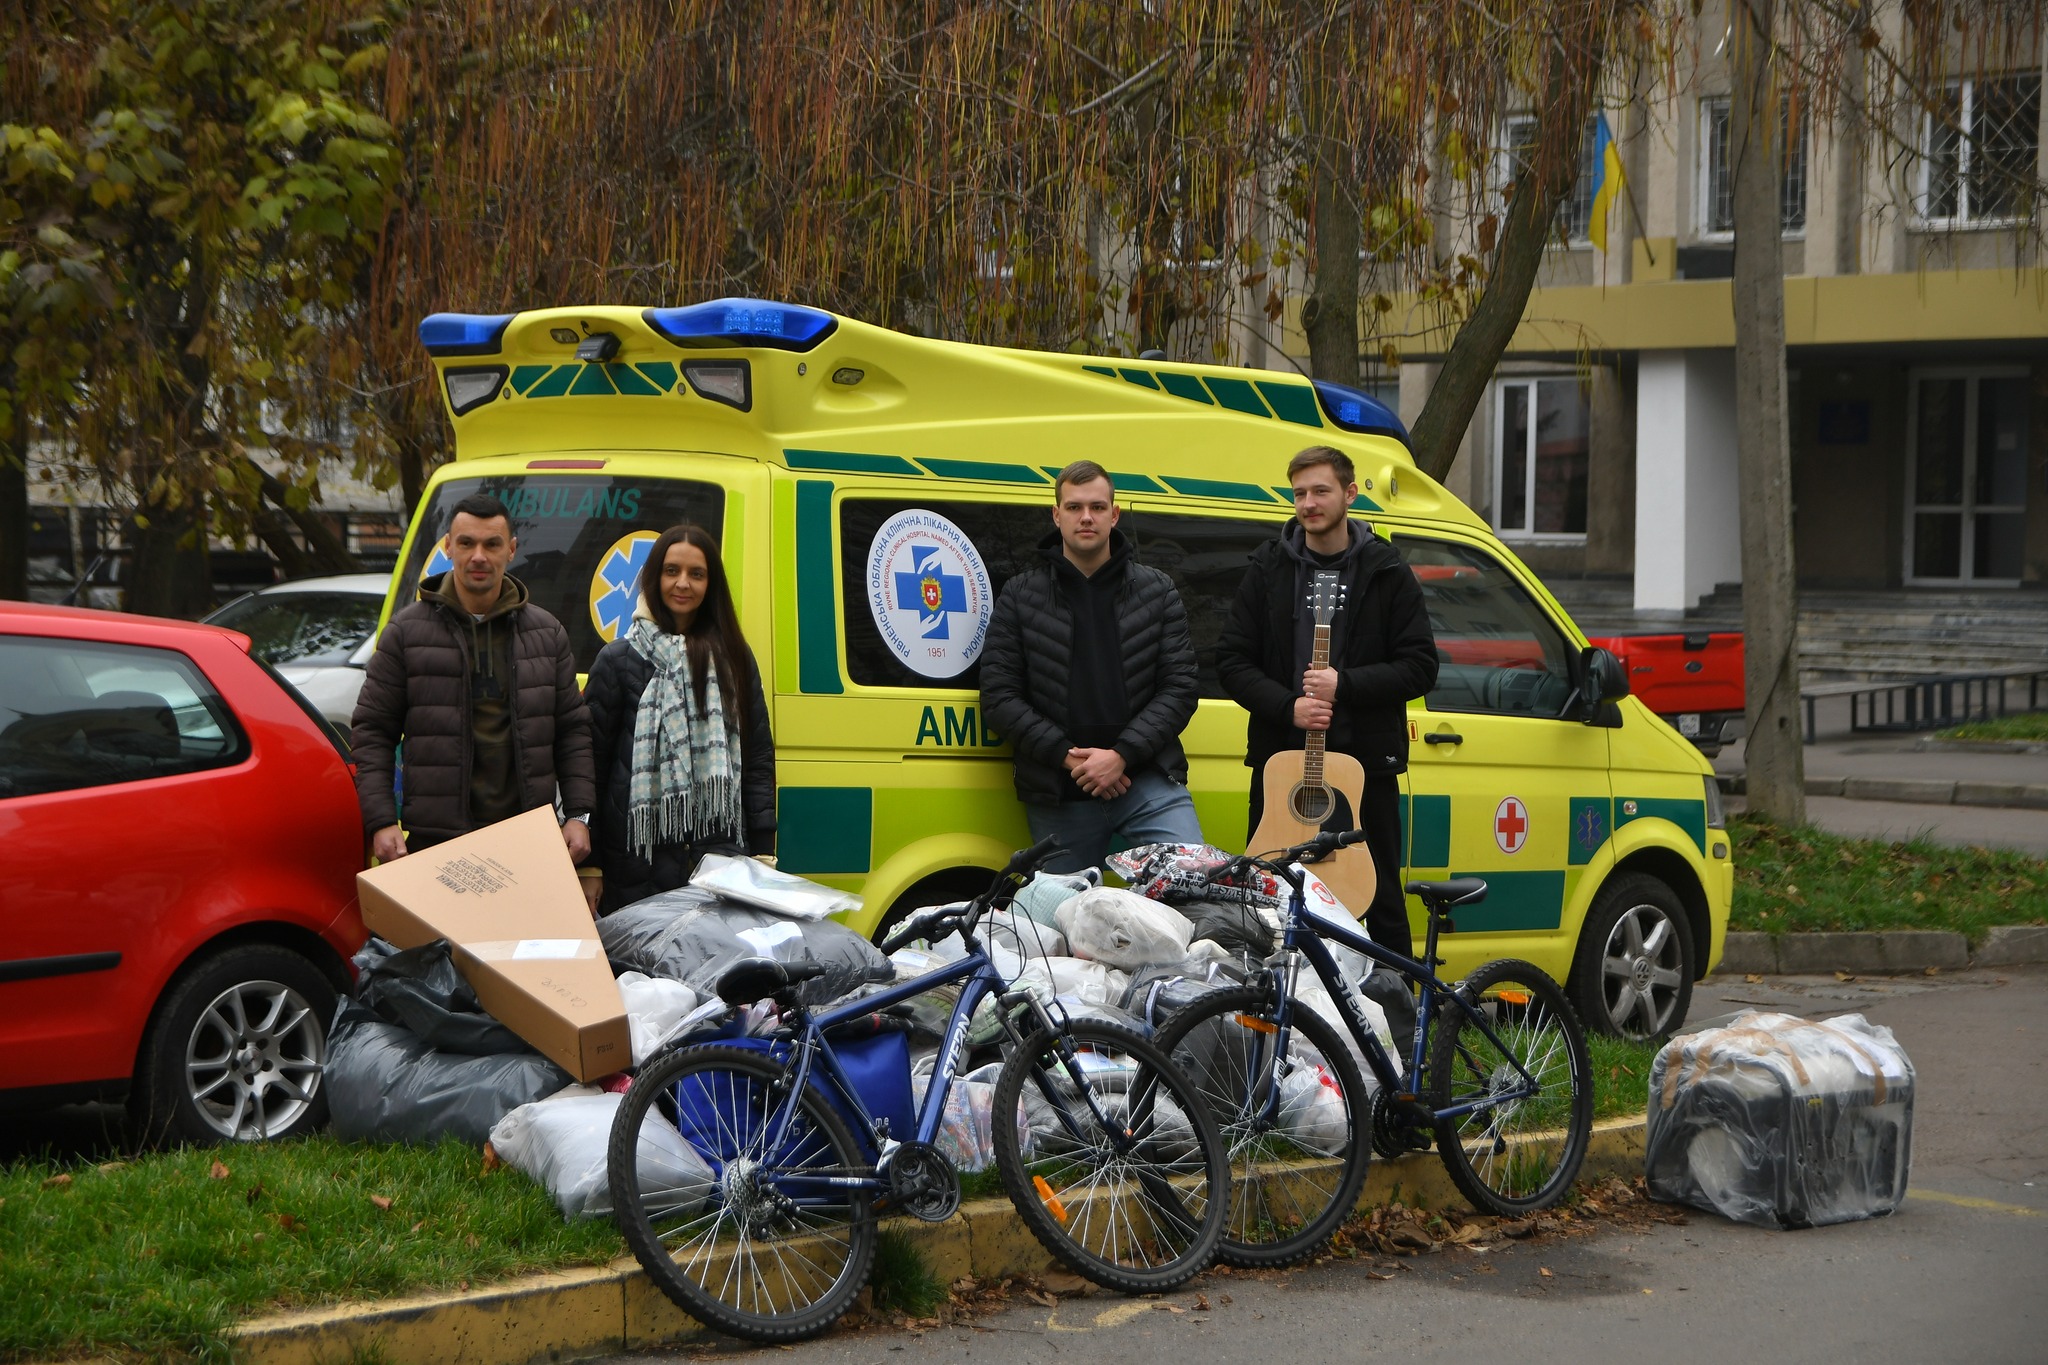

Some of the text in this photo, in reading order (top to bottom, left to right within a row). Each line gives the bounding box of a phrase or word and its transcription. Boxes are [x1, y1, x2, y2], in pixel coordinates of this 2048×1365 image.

[488, 487, 642, 520] MBULANS
[872, 516, 988, 659] РІВНЕНСЬКА ОБЛАСНА КЛІНІЧНА ЛІКАРНЯ ІМЕНІ ЮРІЯ СЕМЕНЮКА
[884, 531, 978, 614] RIVNE REGIONAL CLINICAL HOSPITAL NAMED AFTER YURI SEMENYUK
[927, 648, 946, 657] 1951
[1333, 973, 1372, 1035] STERN
[942, 1012, 971, 1085] STERN
